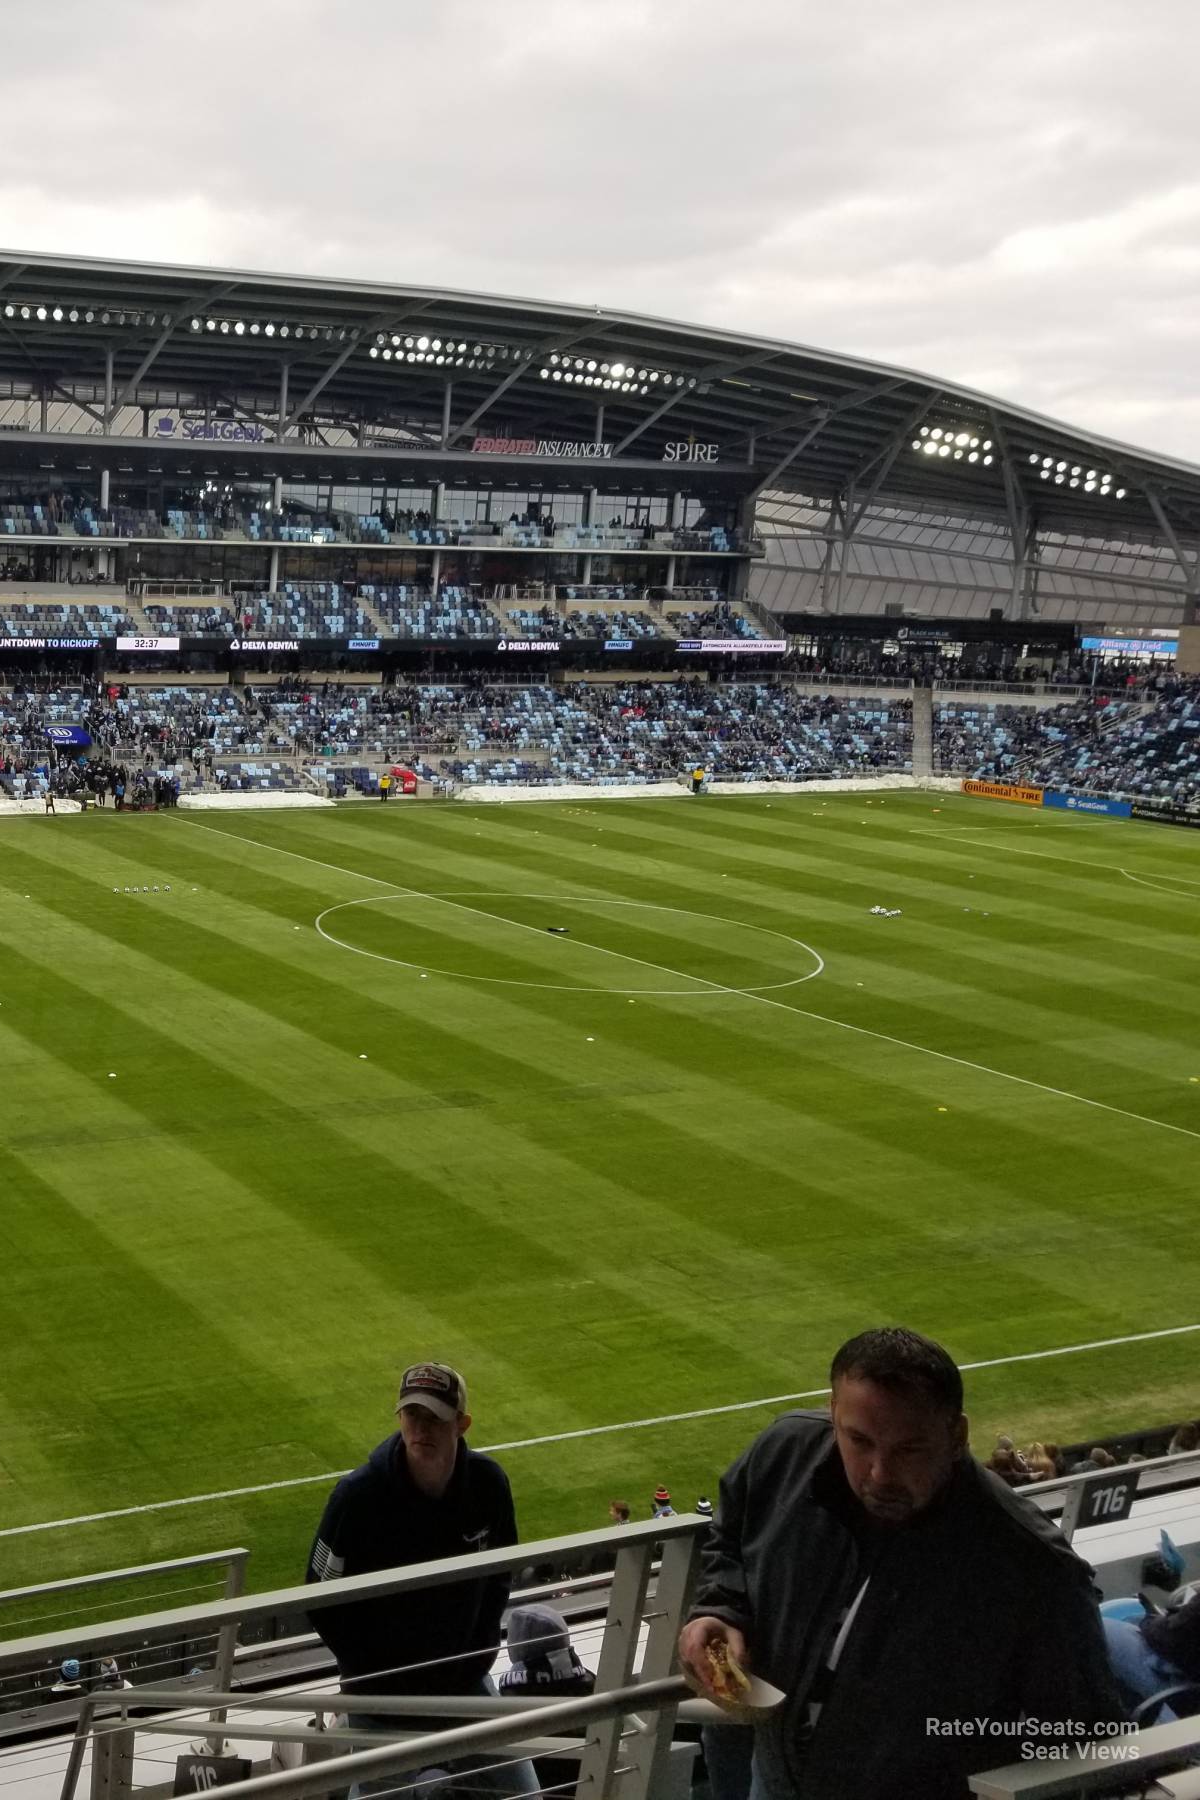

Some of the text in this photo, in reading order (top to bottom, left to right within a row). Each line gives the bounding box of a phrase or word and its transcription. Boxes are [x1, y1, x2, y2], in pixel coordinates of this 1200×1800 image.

[472, 437, 603, 458] FEDERATED INSURANCE
[663, 442, 719, 462] SPIRE
[47, 639, 58, 648] TO
[60, 639, 99, 648] KICKOFF
[135, 639, 158, 648] 32:37
[242, 640, 298, 649] DELTA DENTAL
[508, 642, 560, 650] DELTA DENTAL
[964, 781, 1041, 801] Continental TIRE
[1092, 1485, 1127, 1516] 116
